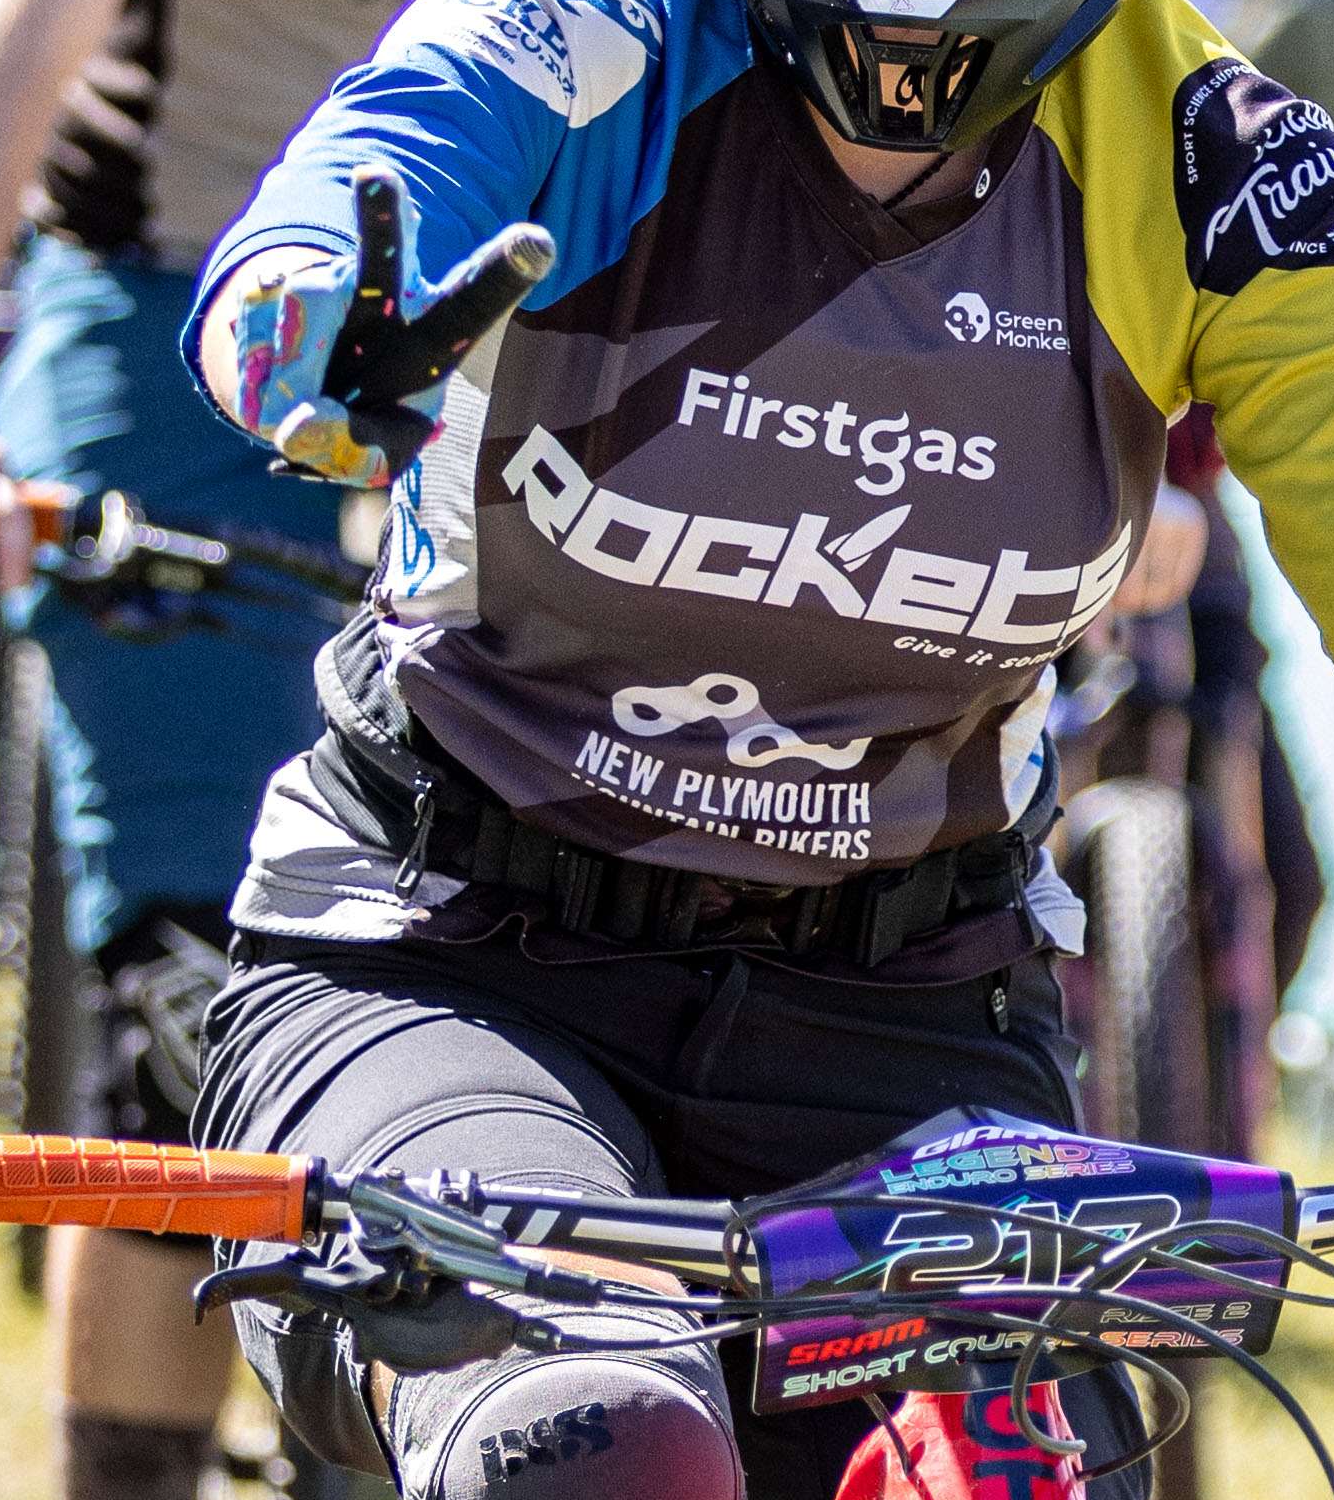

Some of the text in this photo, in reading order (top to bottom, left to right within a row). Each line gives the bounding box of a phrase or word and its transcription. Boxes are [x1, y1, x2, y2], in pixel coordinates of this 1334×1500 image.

[1183, 132, 1199, 185] SPORT
[1288, 240, 1328, 255] INCE
[995, 310, 1063, 332] Green
[676, 367, 998, 496] Firstgas
[893, 635, 957, 659] Give
[964, 649, 995, 667] it
[575, 730, 872, 825] NEW PLYMOUTH
[879, 1143, 1137, 1184] LEGENDS
[886, 1159, 1137, 1196] ENDURO SERIES
[1221, 1300, 1252, 1321] 2
[786, 1316, 927, 1367] SRAM
[781, 1349, 917, 1398] SHORT
